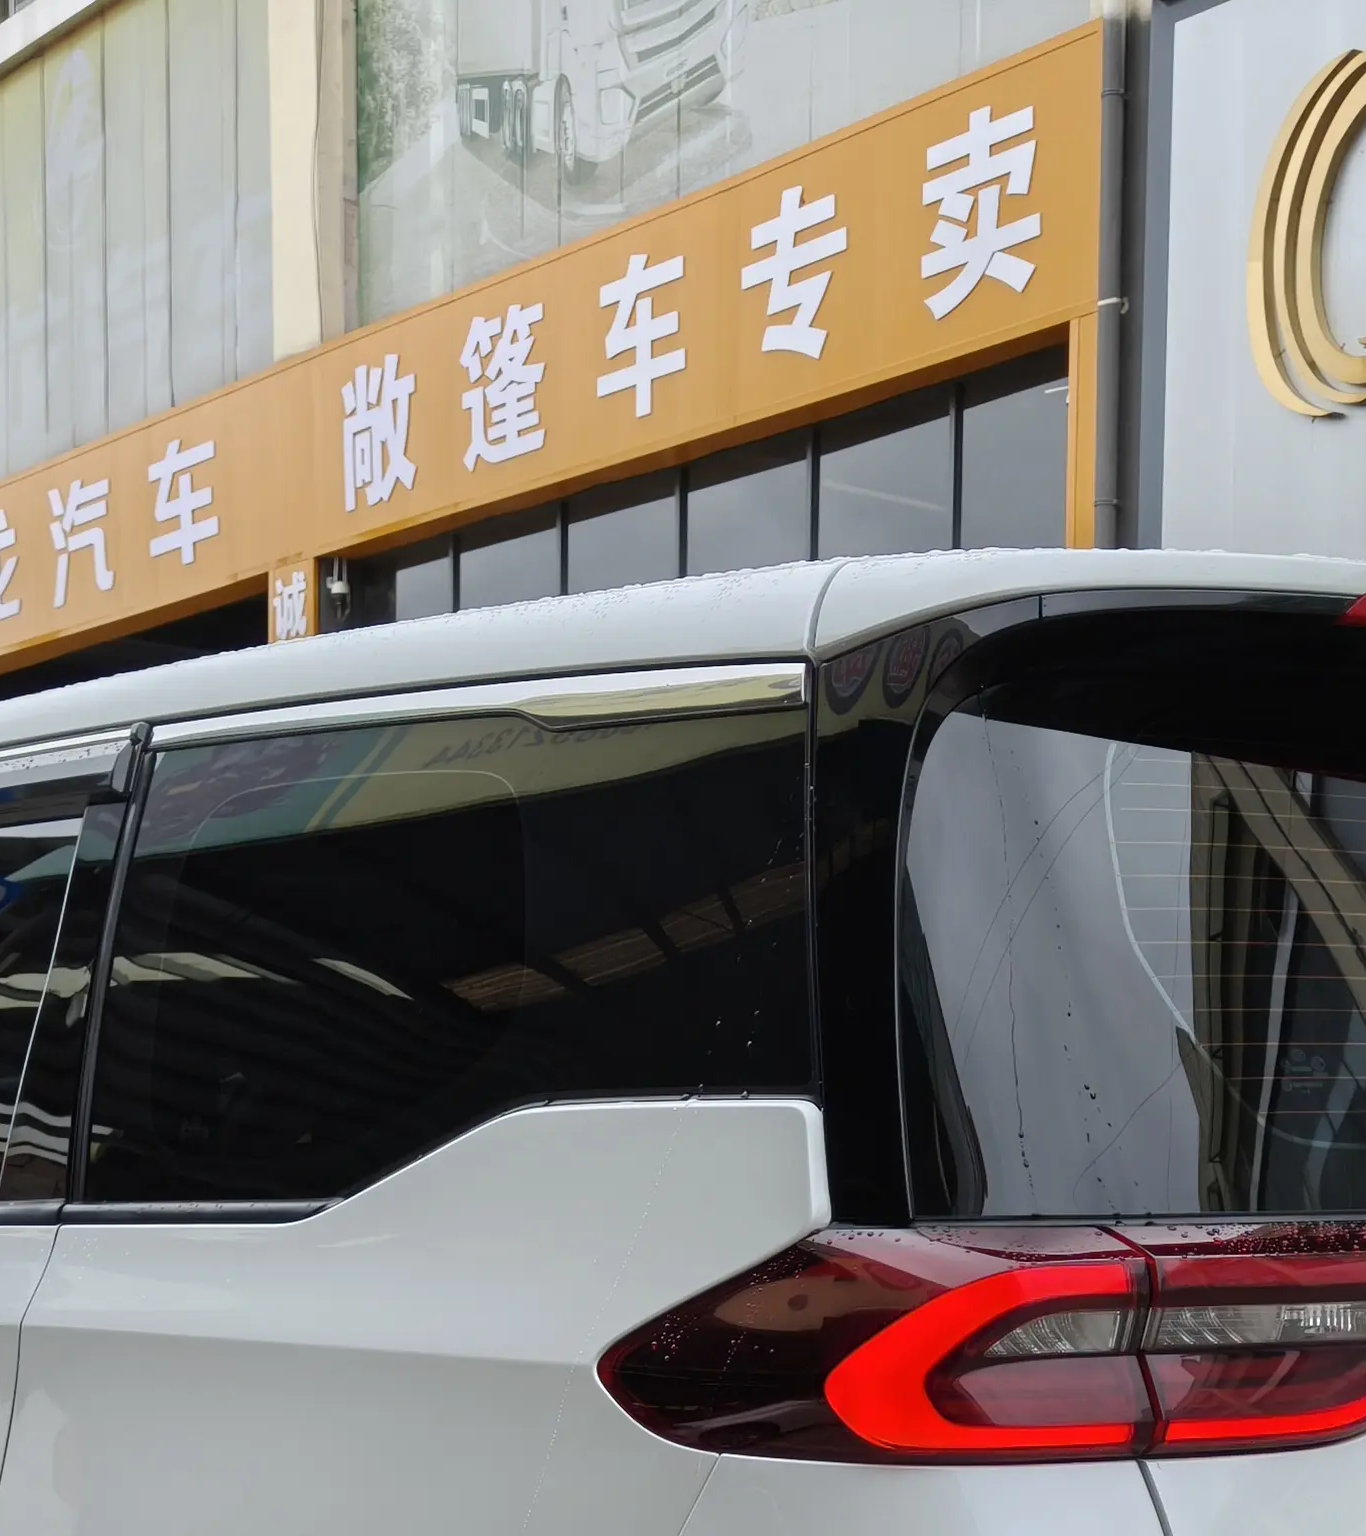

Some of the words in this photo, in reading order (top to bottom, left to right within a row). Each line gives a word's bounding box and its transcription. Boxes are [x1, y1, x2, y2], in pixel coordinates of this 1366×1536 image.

[342, 105, 1041, 513] 敞篷车专卖
